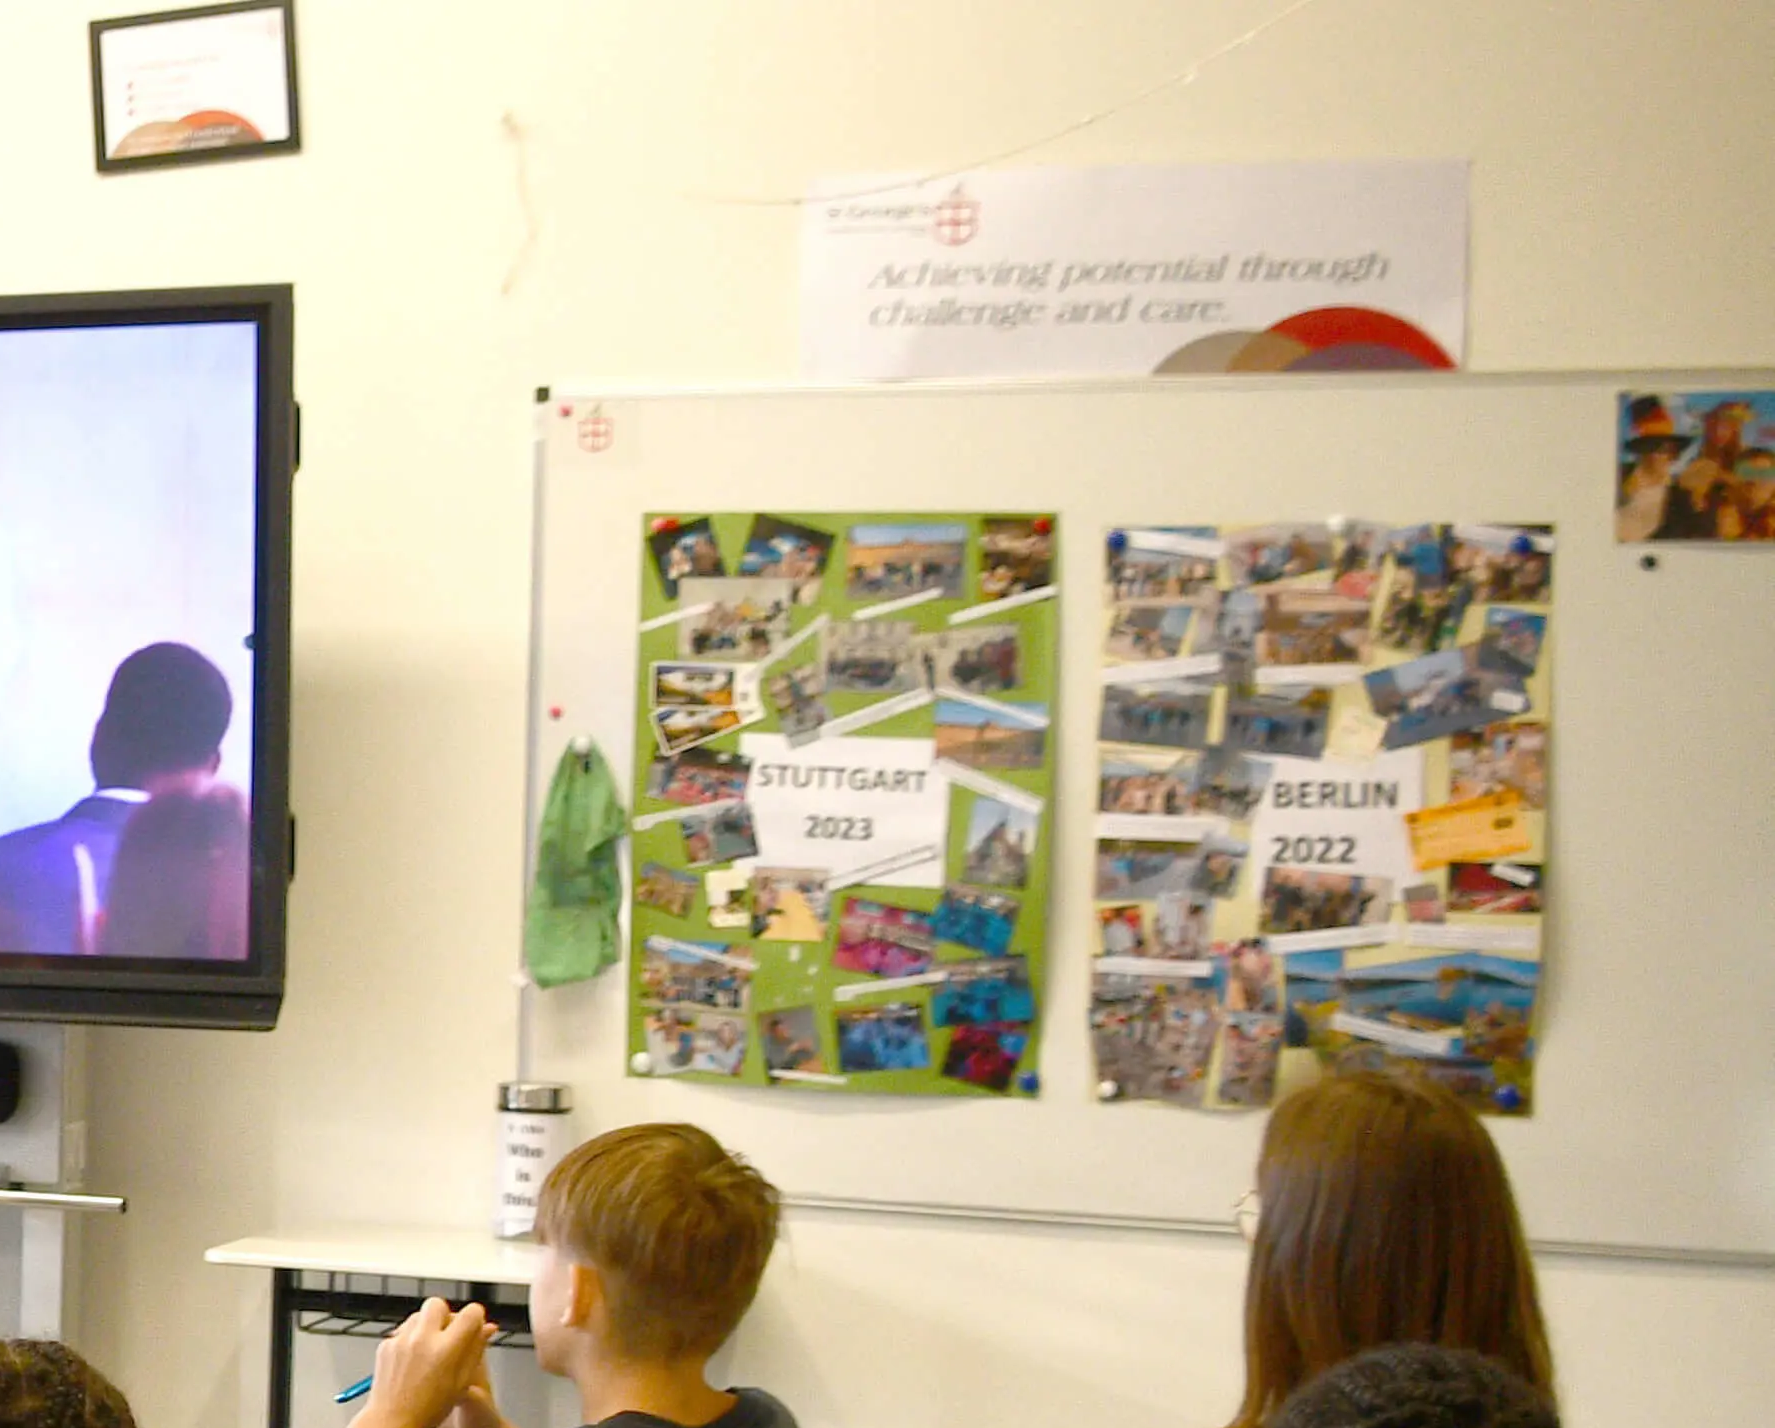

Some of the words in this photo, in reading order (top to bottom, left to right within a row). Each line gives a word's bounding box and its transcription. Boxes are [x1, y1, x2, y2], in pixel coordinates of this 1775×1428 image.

[866, 257, 1055, 292] Achieving
[1056, 253, 1230, 293] potential
[1238, 250, 1393, 286] through
[867, 297, 1050, 331] challenge
[1054, 294, 1134, 325] and
[1138, 299, 1232, 324] care.
[755, 763, 928, 793] STUTTGART
[1271, 779, 1399, 810] BERLIN
[803, 813, 875, 842] 2023
[1270, 835, 1357, 865] 2022
